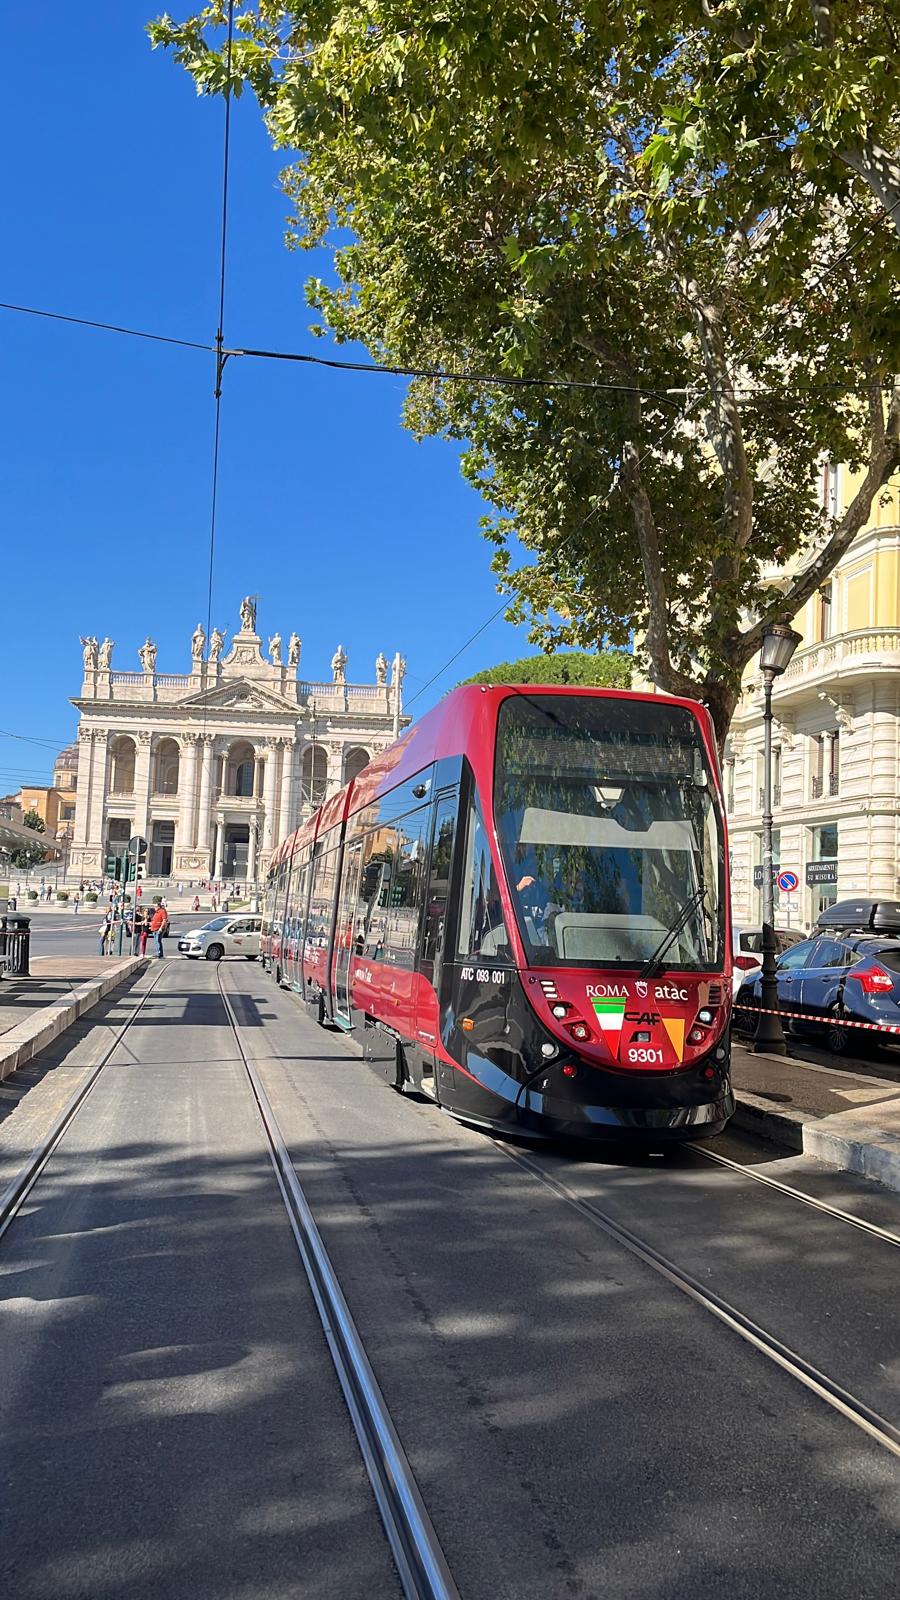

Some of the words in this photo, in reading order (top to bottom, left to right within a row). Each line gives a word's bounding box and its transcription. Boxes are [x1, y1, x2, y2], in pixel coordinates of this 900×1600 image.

[460, 967, 474, 981] ATC
[476, 969, 490, 983] 093
[492, 970, 505, 984] 001
[585, 984, 630, 997] ROMA
[654, 985, 689, 1001] atac
[624, 1011, 661, 1026] CAF
[628, 1048, 664, 1063] 9301
